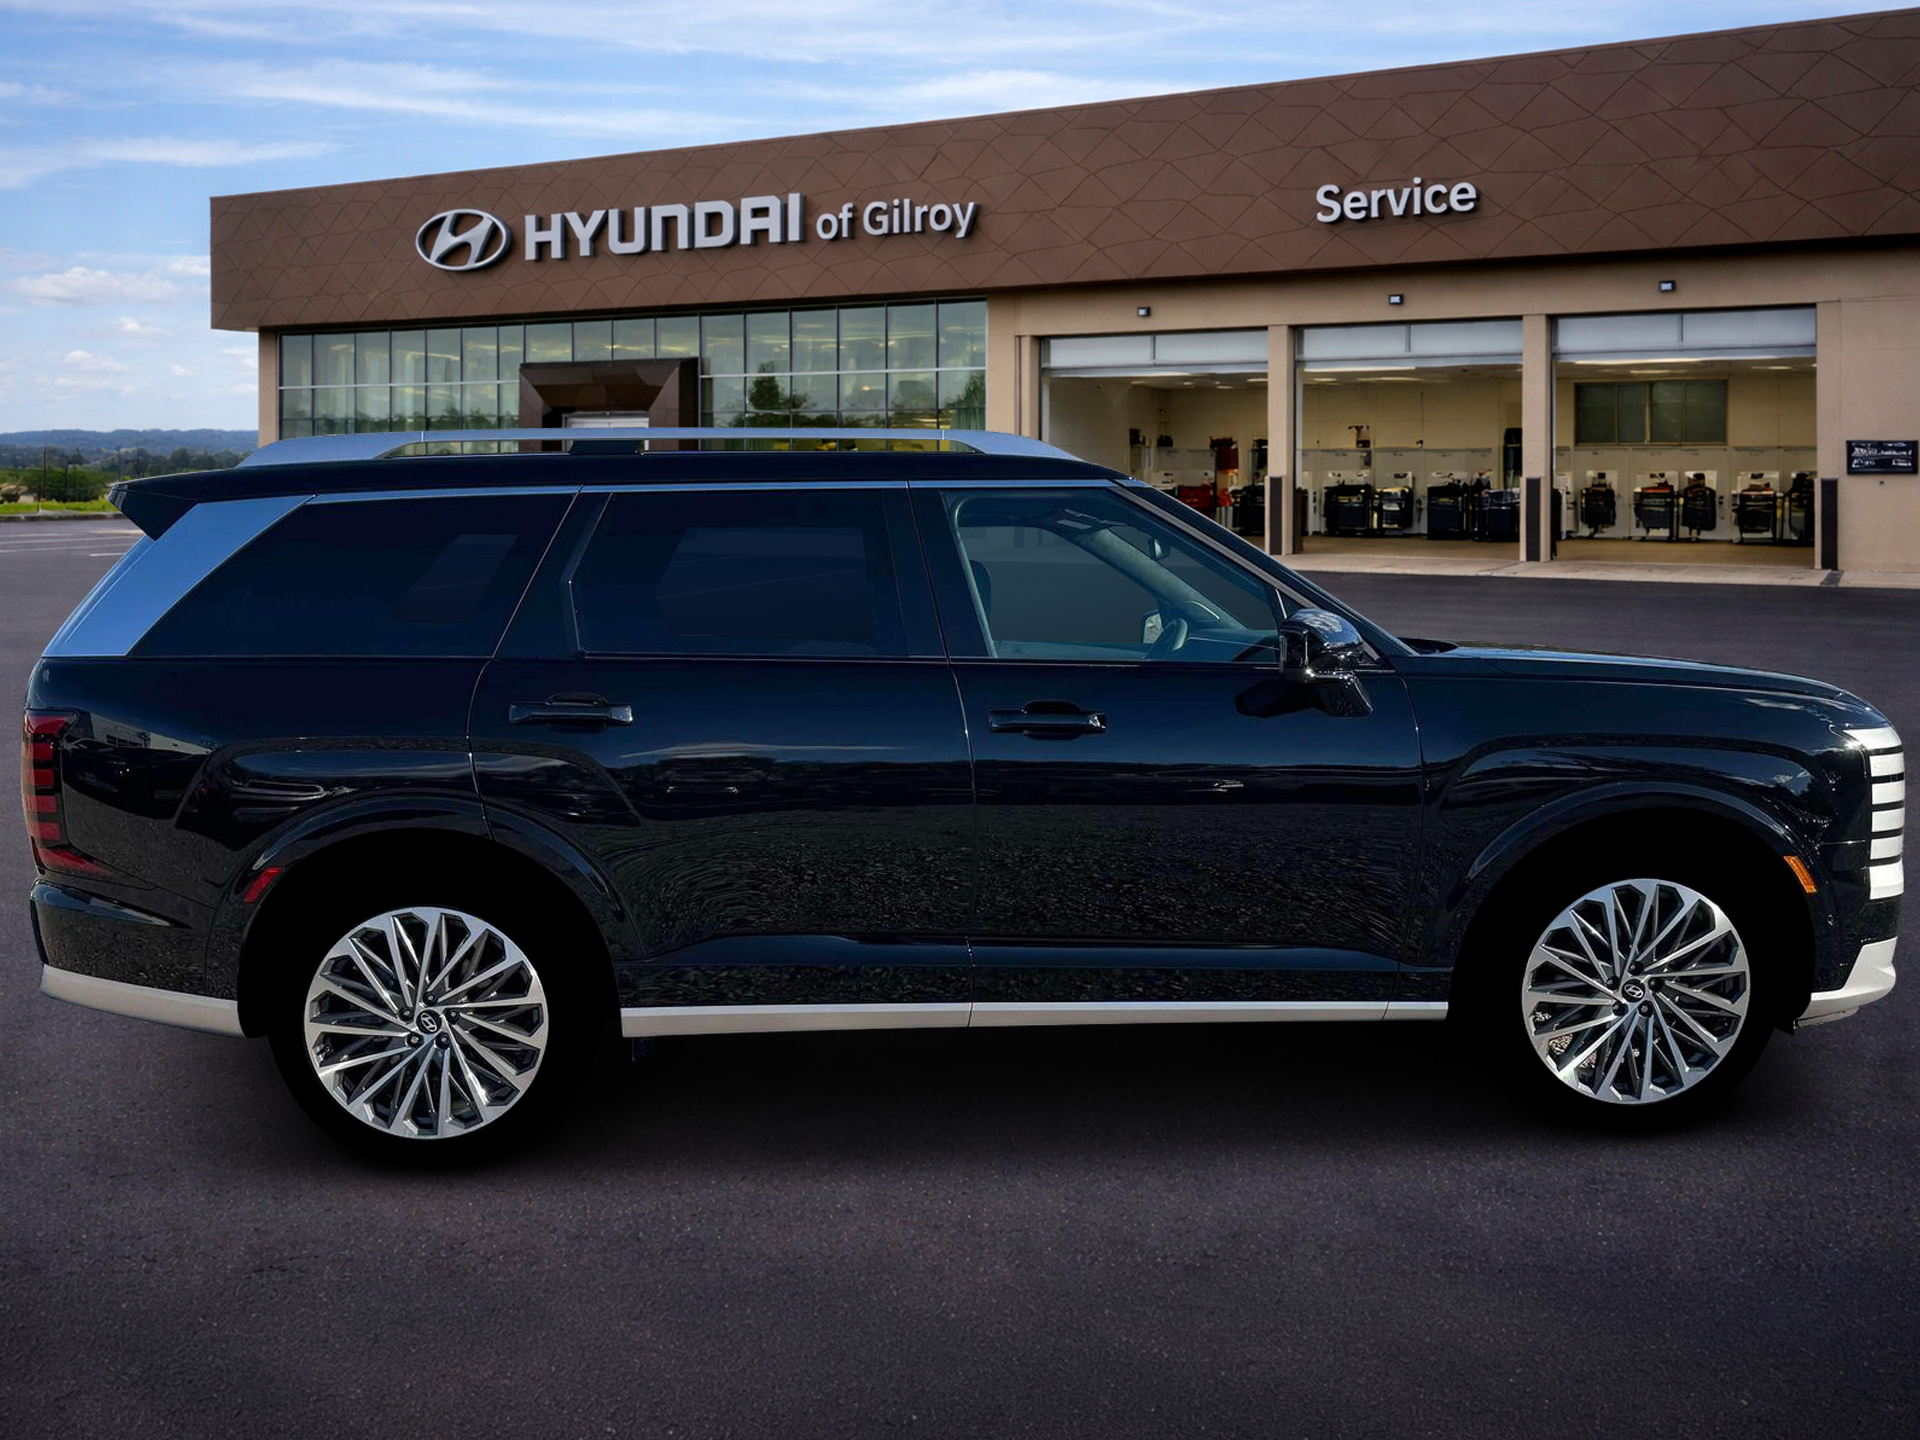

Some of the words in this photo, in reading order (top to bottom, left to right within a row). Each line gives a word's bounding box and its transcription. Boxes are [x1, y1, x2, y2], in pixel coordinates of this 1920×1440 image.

[523, 192, 802, 261] HYUNDAI
[815, 202, 855, 240] of
[862, 198, 976, 239] Gilroy
[1314, 176, 1479, 224] Service
